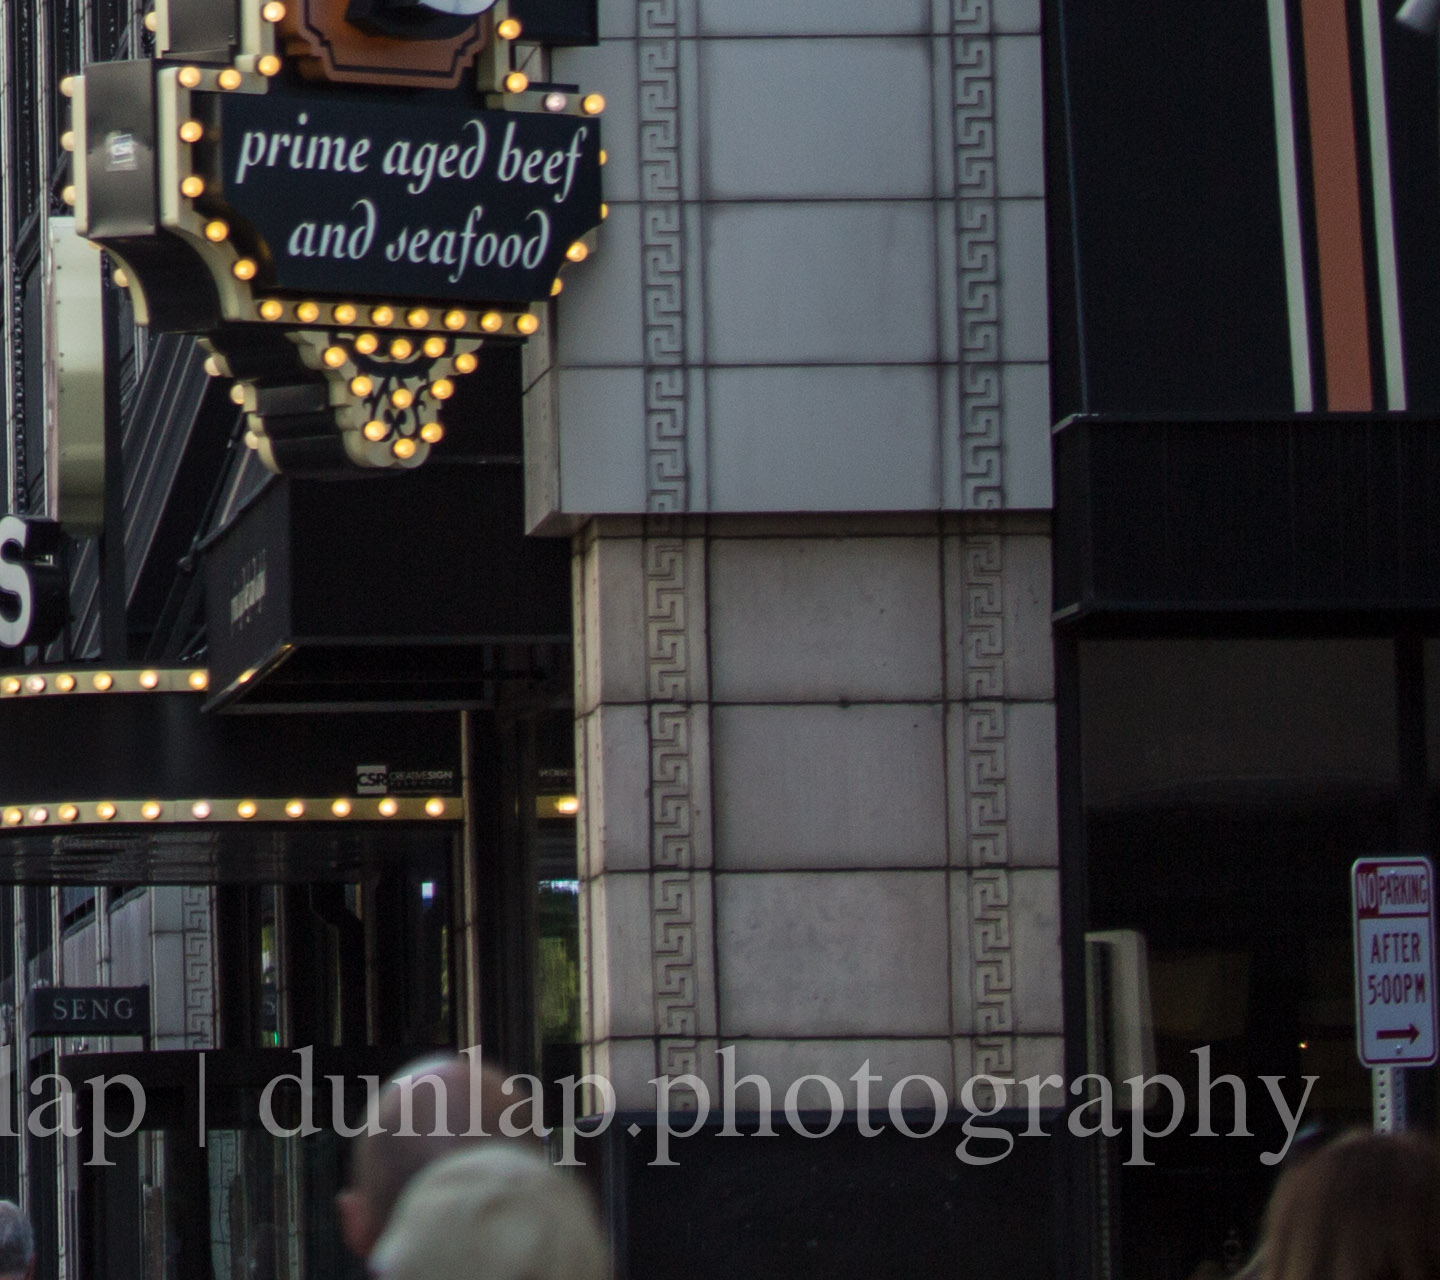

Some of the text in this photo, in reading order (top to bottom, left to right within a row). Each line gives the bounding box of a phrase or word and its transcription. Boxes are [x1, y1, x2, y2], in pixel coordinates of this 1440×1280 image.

[234, 113, 590, 202] prime aged beef
[287, 197, 553, 285] and seafood
[1357, 872, 1427, 910] NO PARKING
[1370, 933, 1421, 963] AFTER
[1367, 973, 1426, 1006] 5:00PM
[53, 997, 134, 1021] SENG
